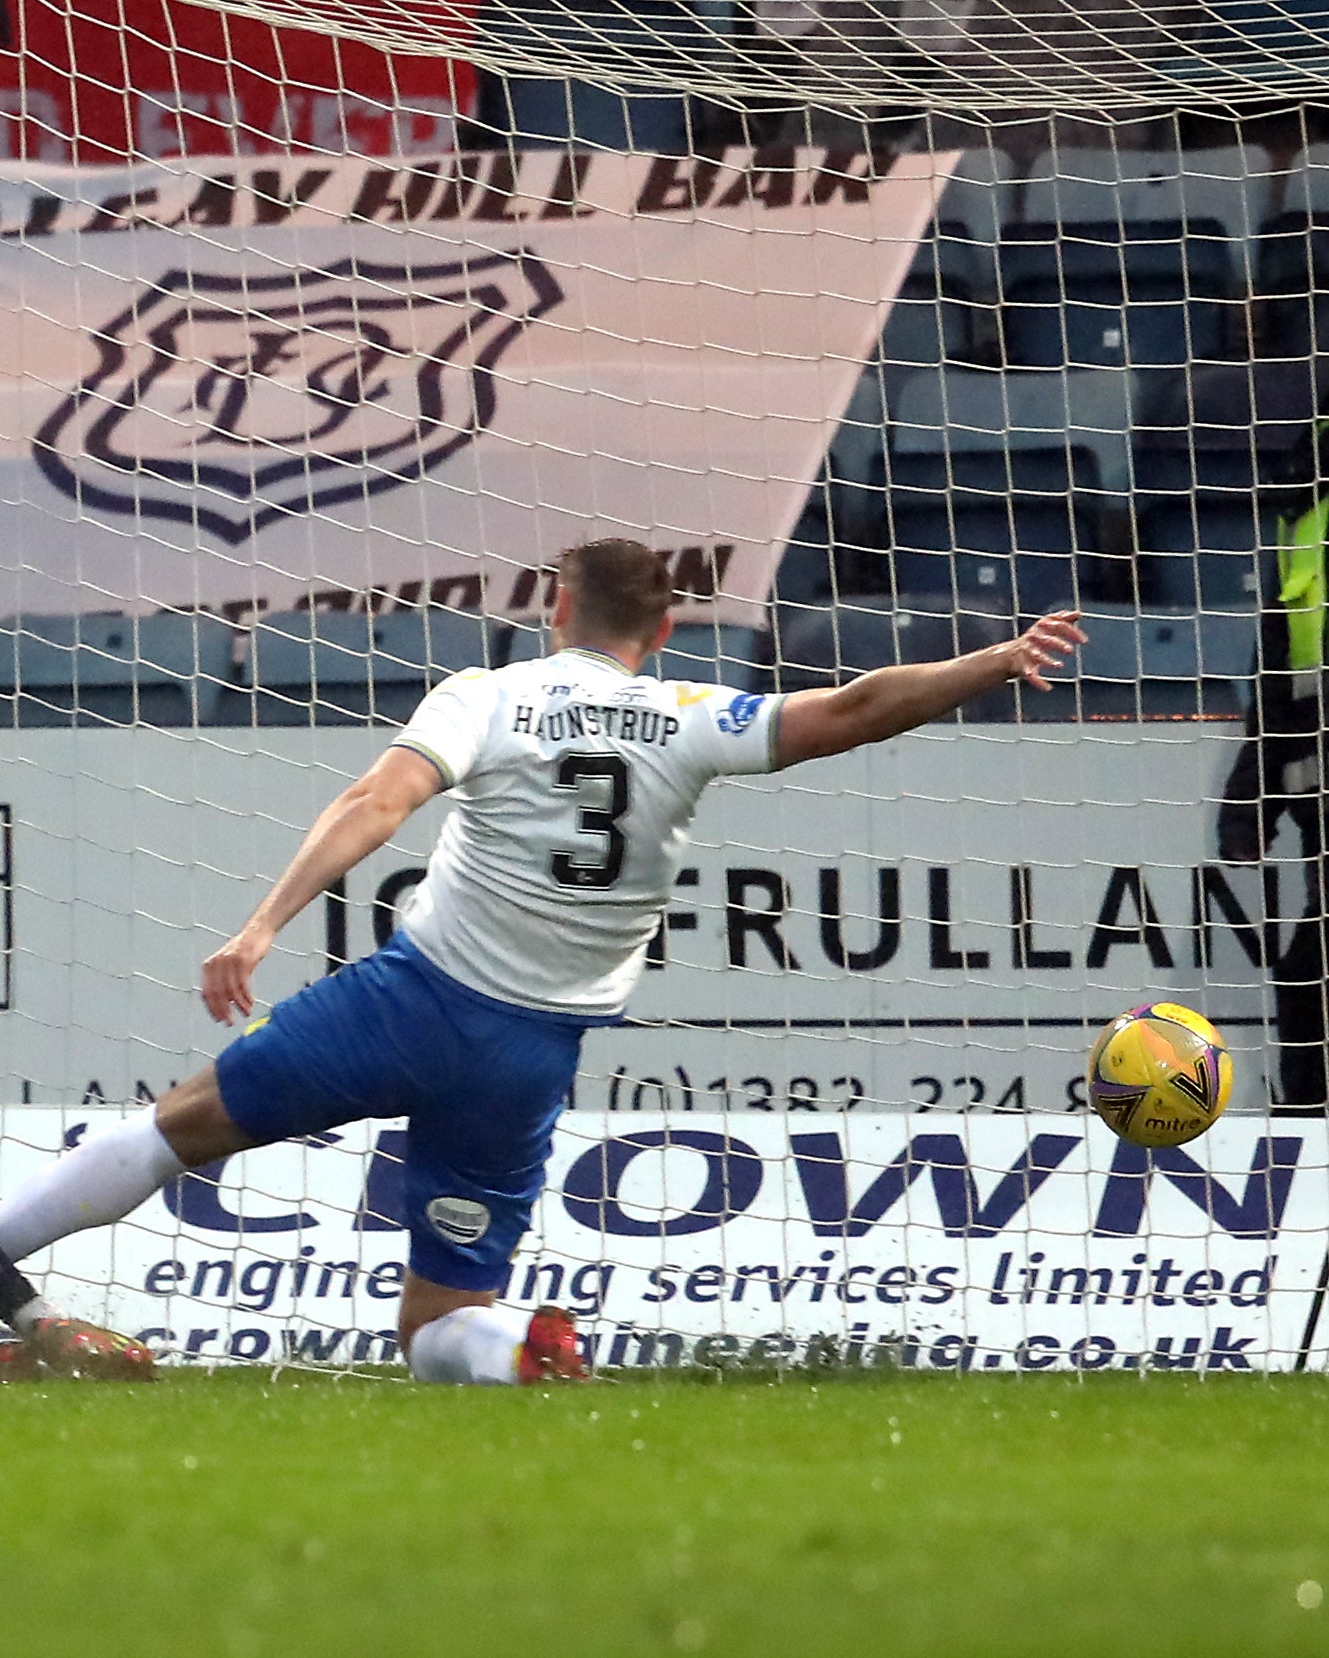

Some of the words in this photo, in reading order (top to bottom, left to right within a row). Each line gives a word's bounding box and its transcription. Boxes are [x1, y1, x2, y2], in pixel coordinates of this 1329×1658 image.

[513, 704, 680, 746] HAUNSTRUP
[550, 750, 632, 890] 3
[1145, 1117, 1201, 1131] mitre
[144, 1246, 616, 1316] engineng
[643, 1250, 958, 1304] services
[988, 1251, 1276, 1308] limited
